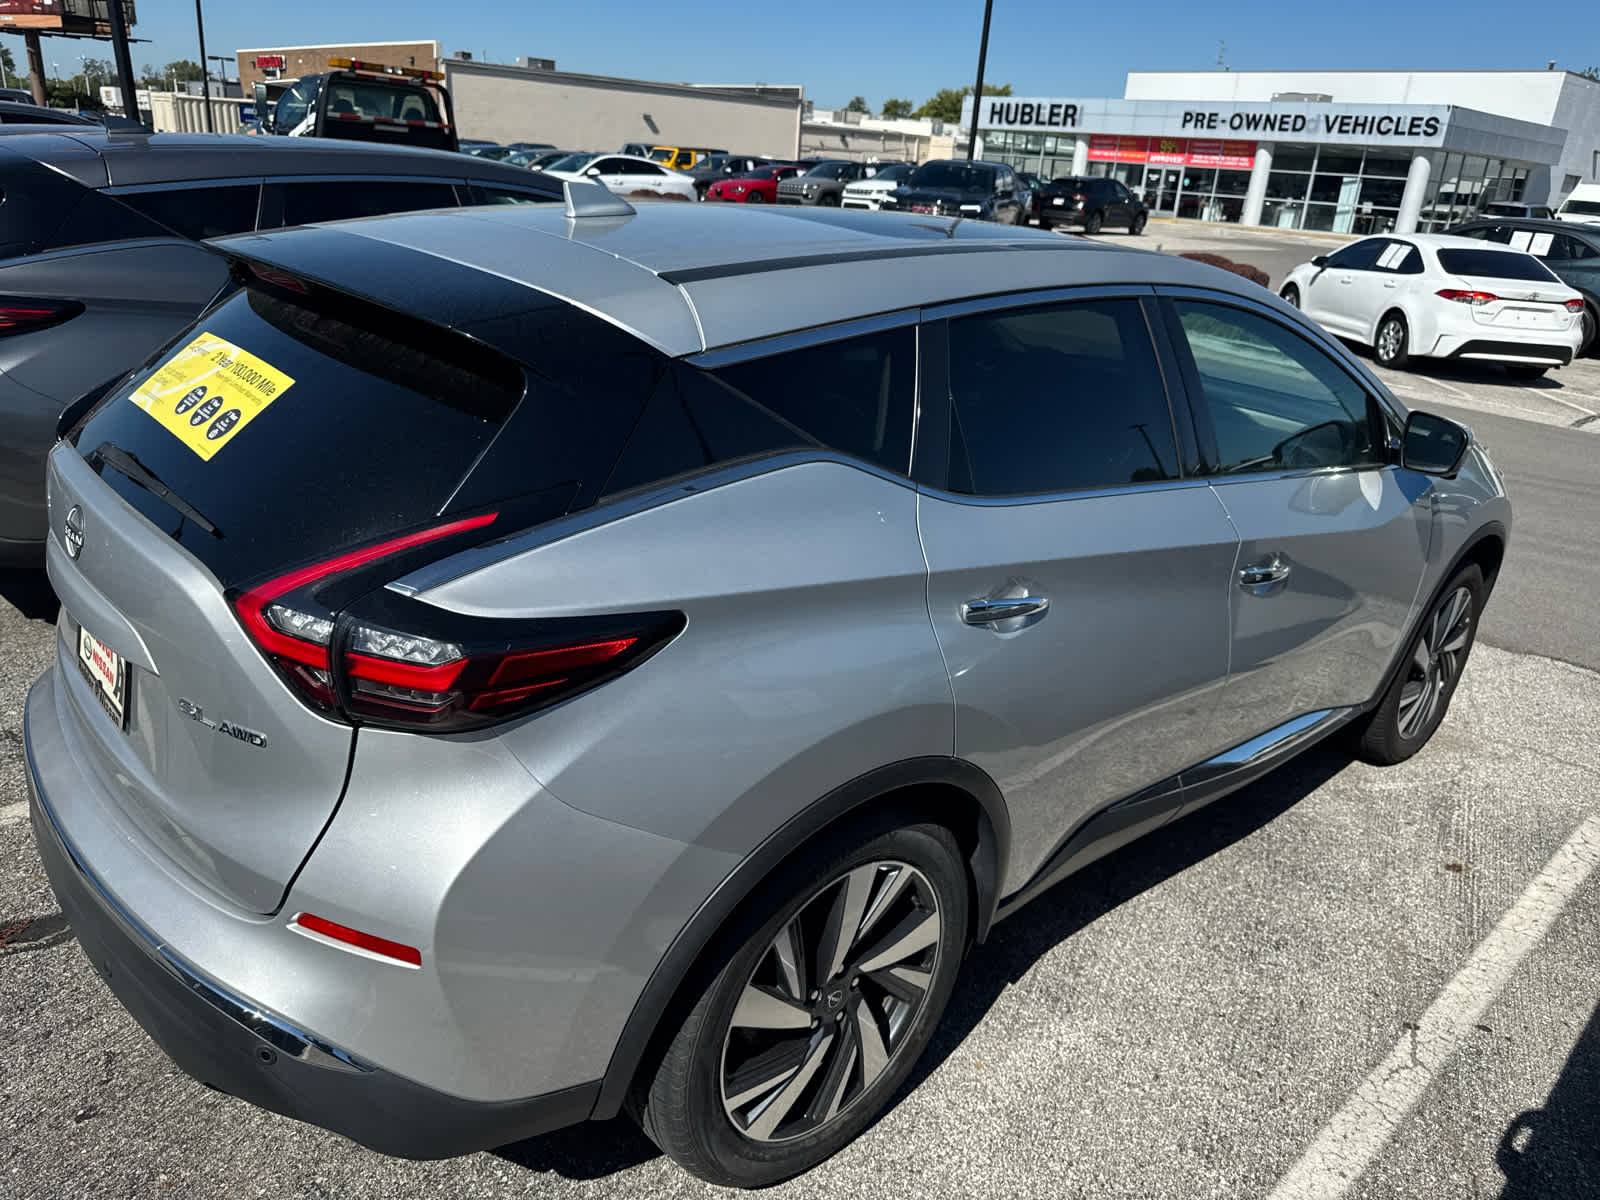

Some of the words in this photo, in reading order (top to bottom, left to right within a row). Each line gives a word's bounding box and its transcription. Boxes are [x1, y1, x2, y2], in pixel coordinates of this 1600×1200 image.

[990, 102, 1078, 127] HUBLER
[1182, 112, 1306, 132] PRE-OWNED
[1325, 114, 1441, 137] VEHICLES
[93, 650, 114, 687] NISSAN
[219, 720, 267, 749] AWD
